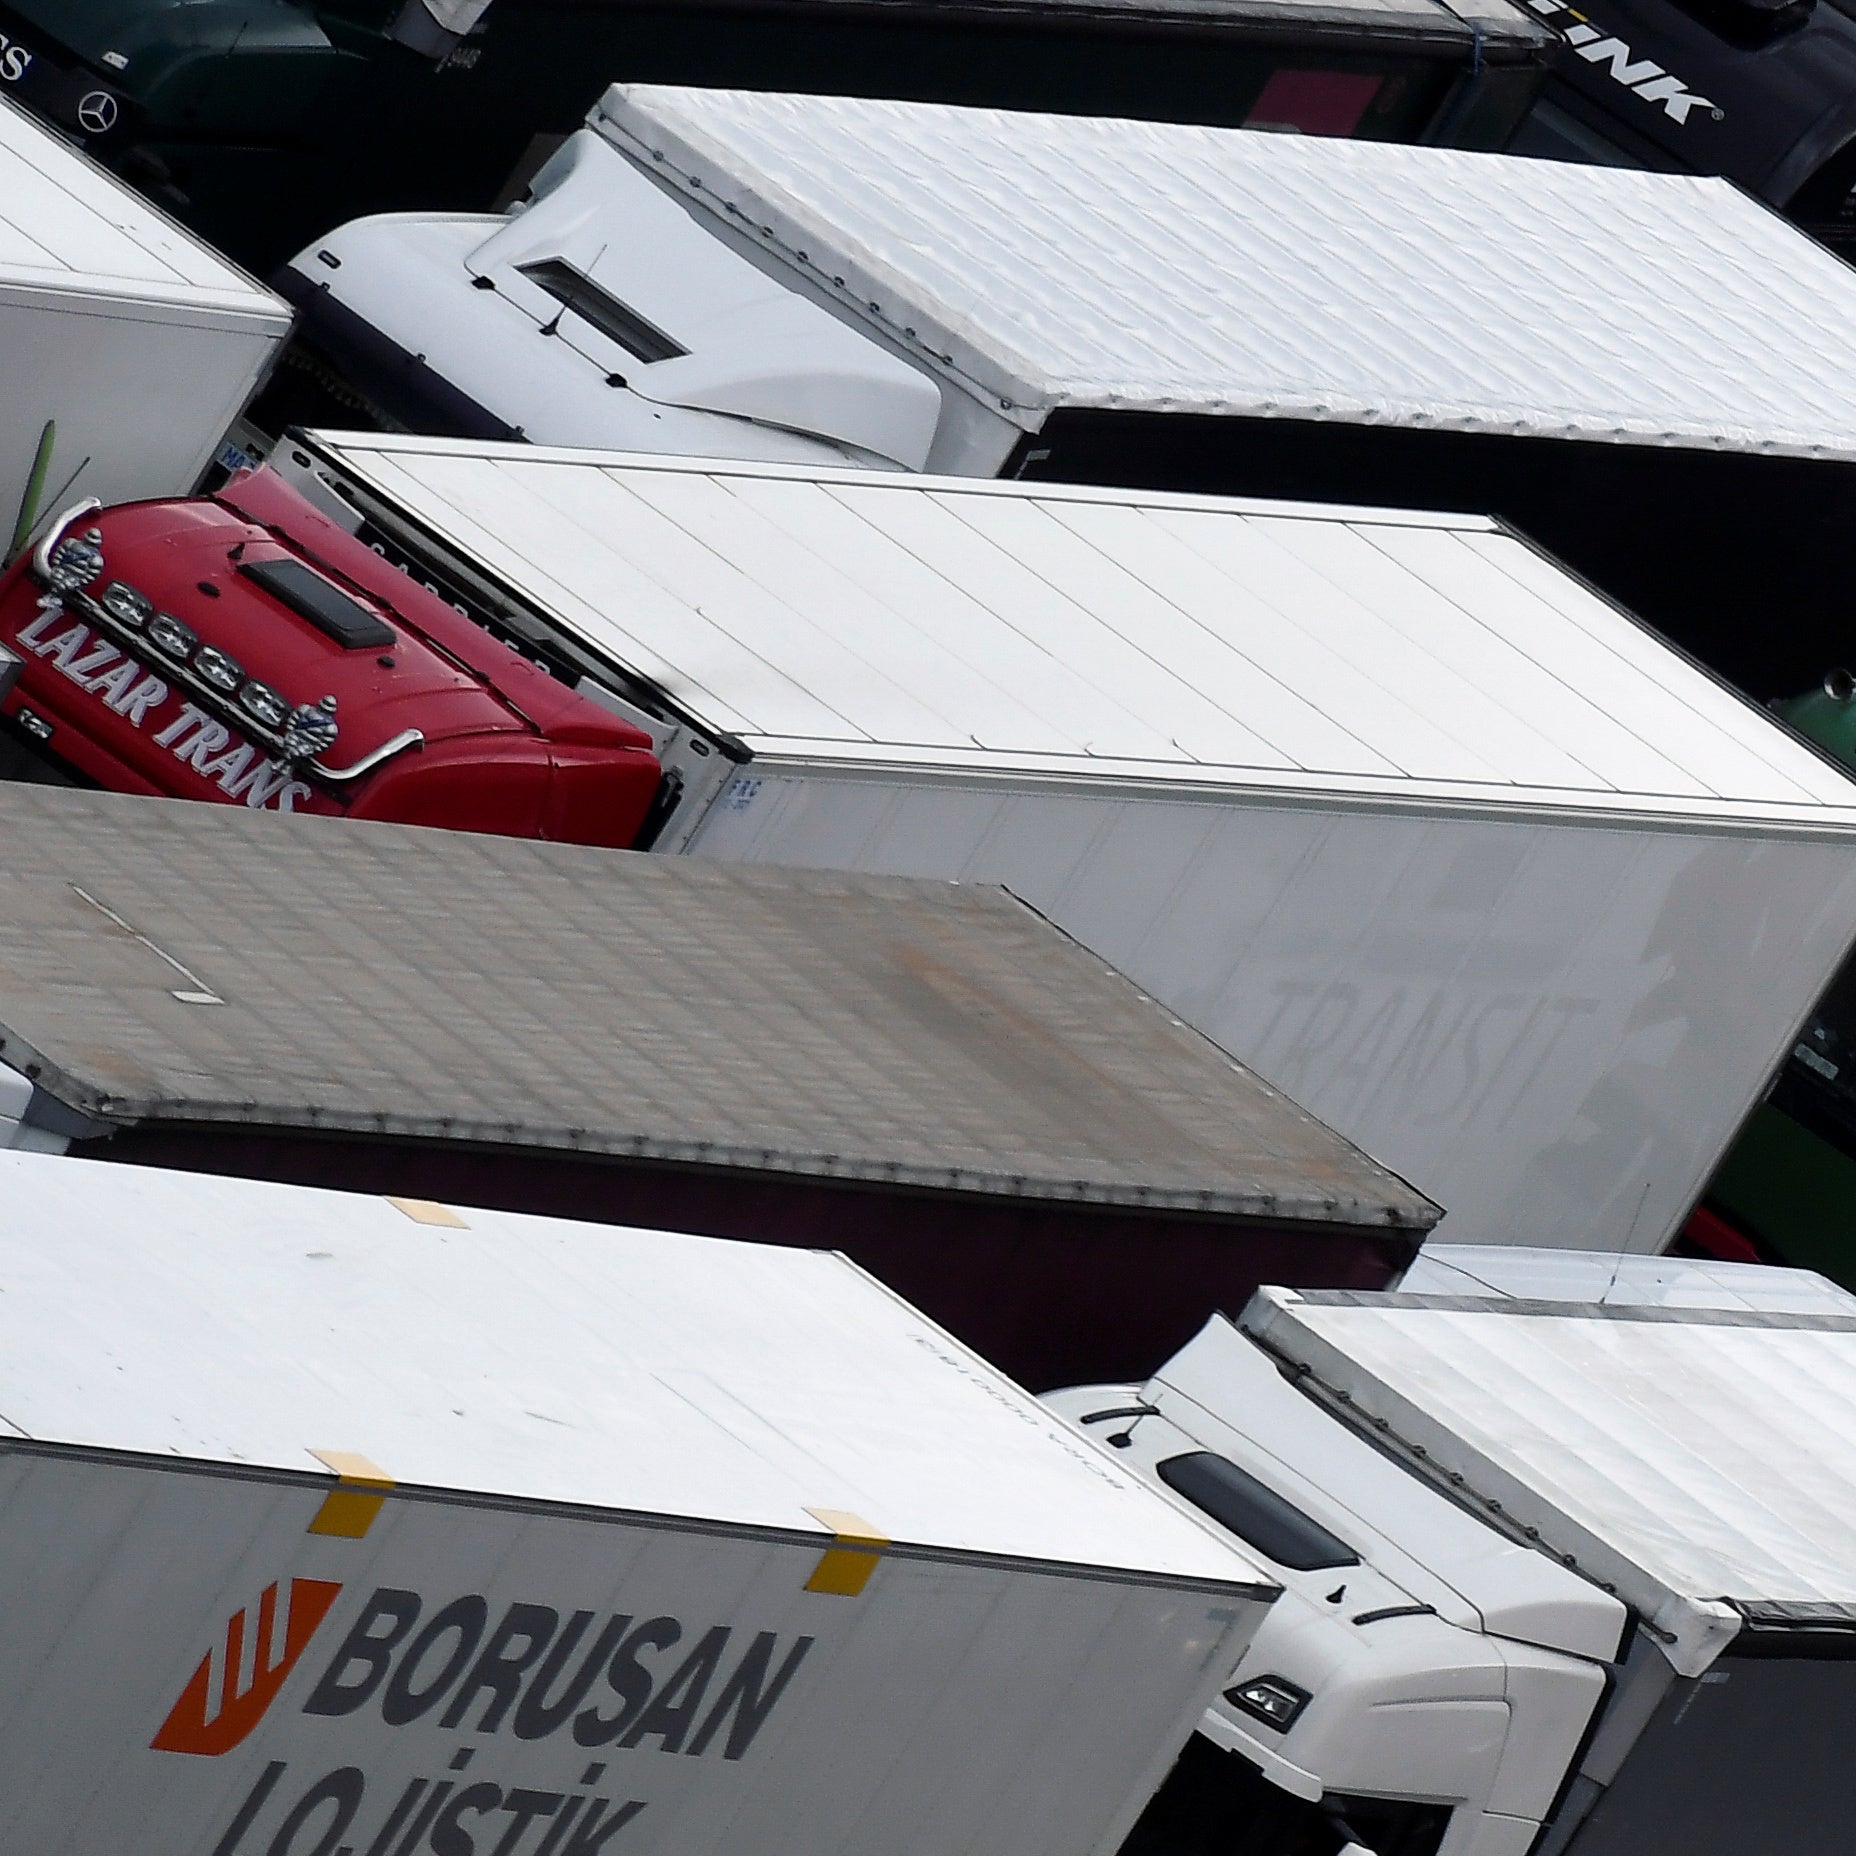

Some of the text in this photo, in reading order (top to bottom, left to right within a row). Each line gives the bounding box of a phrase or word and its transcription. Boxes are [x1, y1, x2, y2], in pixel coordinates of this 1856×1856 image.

[0, 33, 32, 80] S
[15, 601, 169, 728] LAZAR
[303, 1586, 814, 1761] BORUSAN
